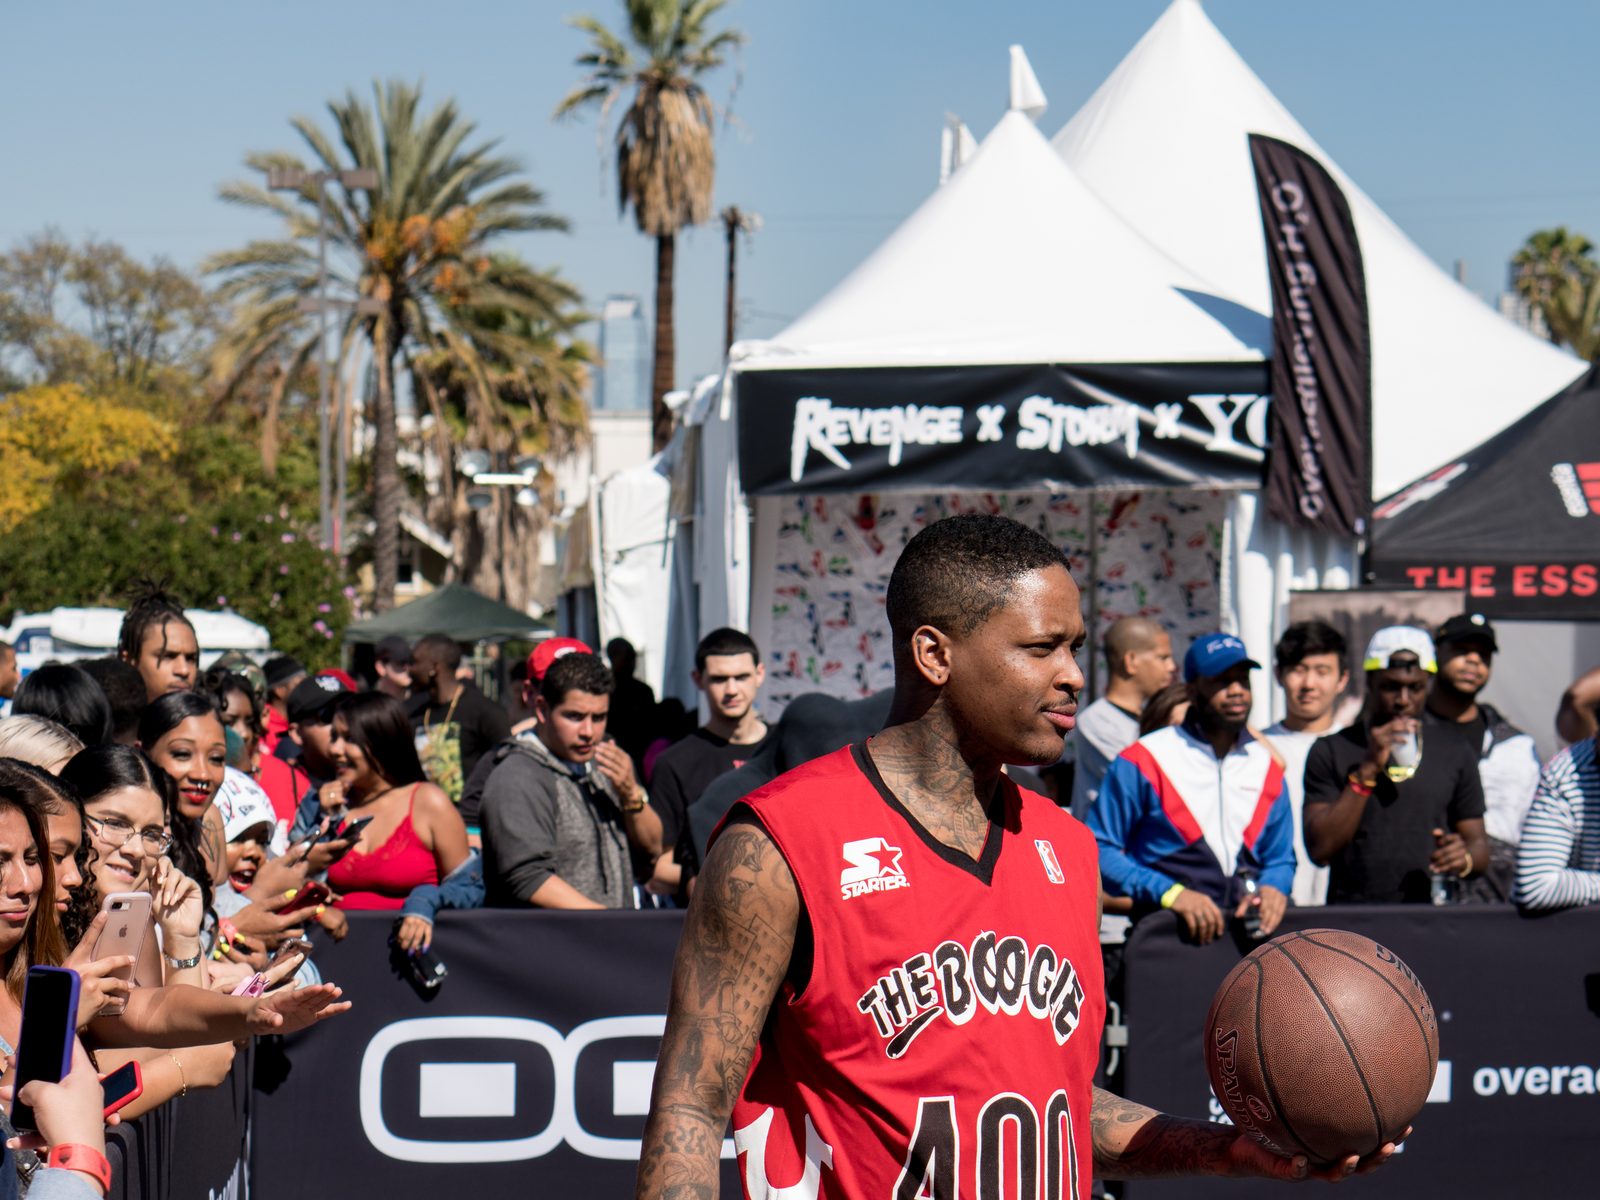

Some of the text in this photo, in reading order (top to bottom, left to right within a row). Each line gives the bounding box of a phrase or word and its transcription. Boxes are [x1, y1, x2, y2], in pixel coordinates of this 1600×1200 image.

[1405, 565, 1497, 598] THE
[856, 930, 1085, 1047] THE BOOGIE
[1473, 1065, 1600, 1097] overa
